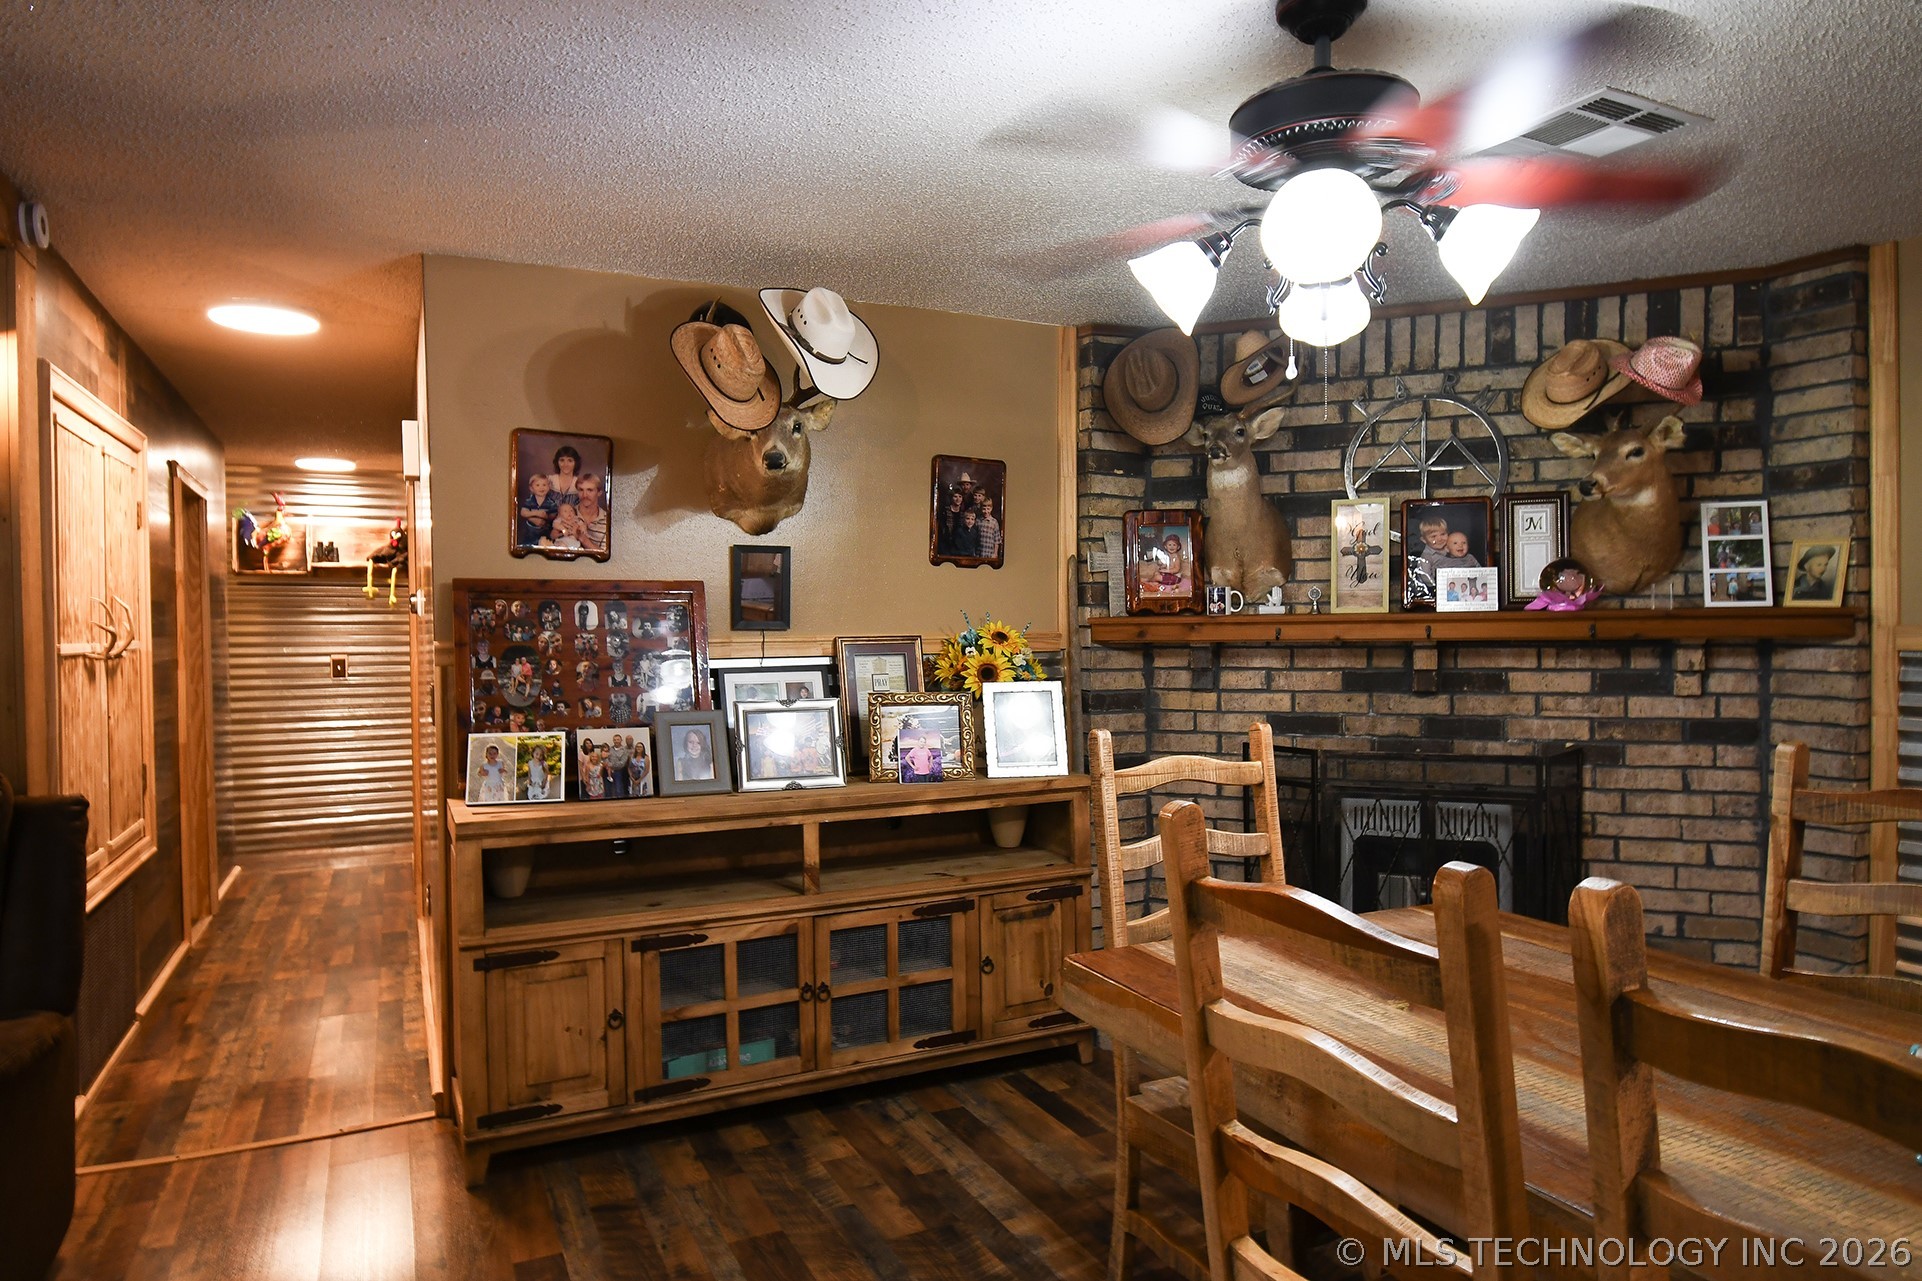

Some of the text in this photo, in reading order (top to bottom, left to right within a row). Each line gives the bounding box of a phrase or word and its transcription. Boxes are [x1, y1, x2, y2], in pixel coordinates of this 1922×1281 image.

[1346, 521, 1381, 545] God
[1524, 516, 1544, 532] M
[1346, 565, 1381, 588] You
[874, 678, 888, 687] PRAY
